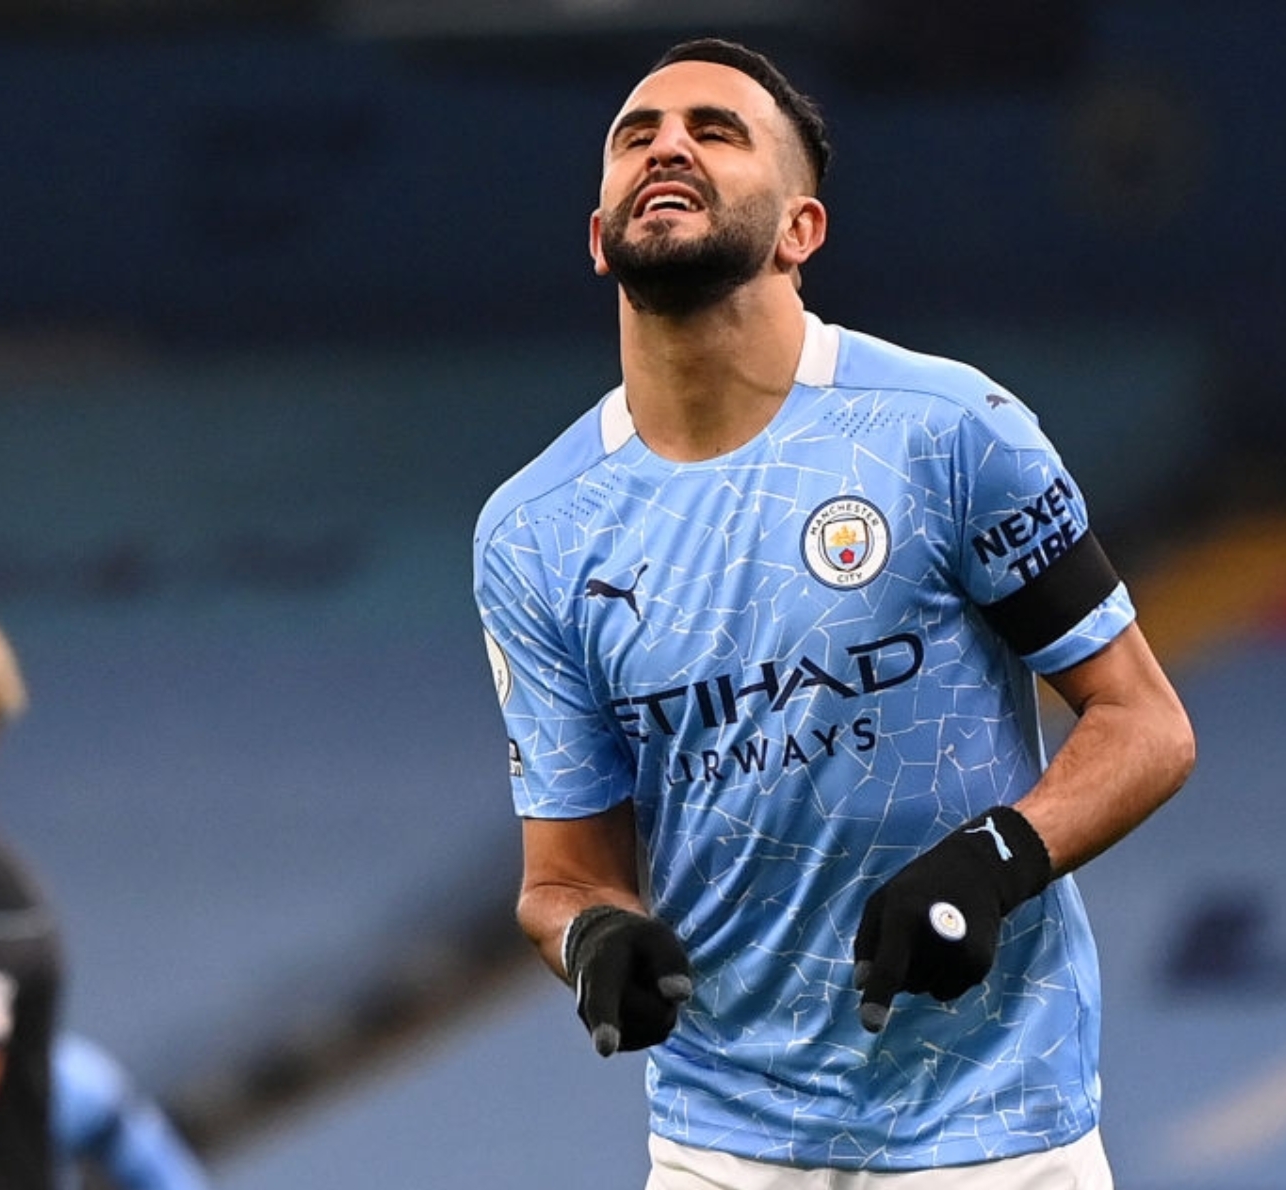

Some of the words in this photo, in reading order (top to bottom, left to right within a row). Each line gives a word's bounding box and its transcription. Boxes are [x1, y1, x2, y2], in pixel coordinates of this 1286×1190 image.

[810, 503, 879, 535] MANCHESTER
[836, 572, 862, 583] CITY
[611, 633, 924, 743] ETIHAD
[665, 717, 876, 786] IRWAYS
